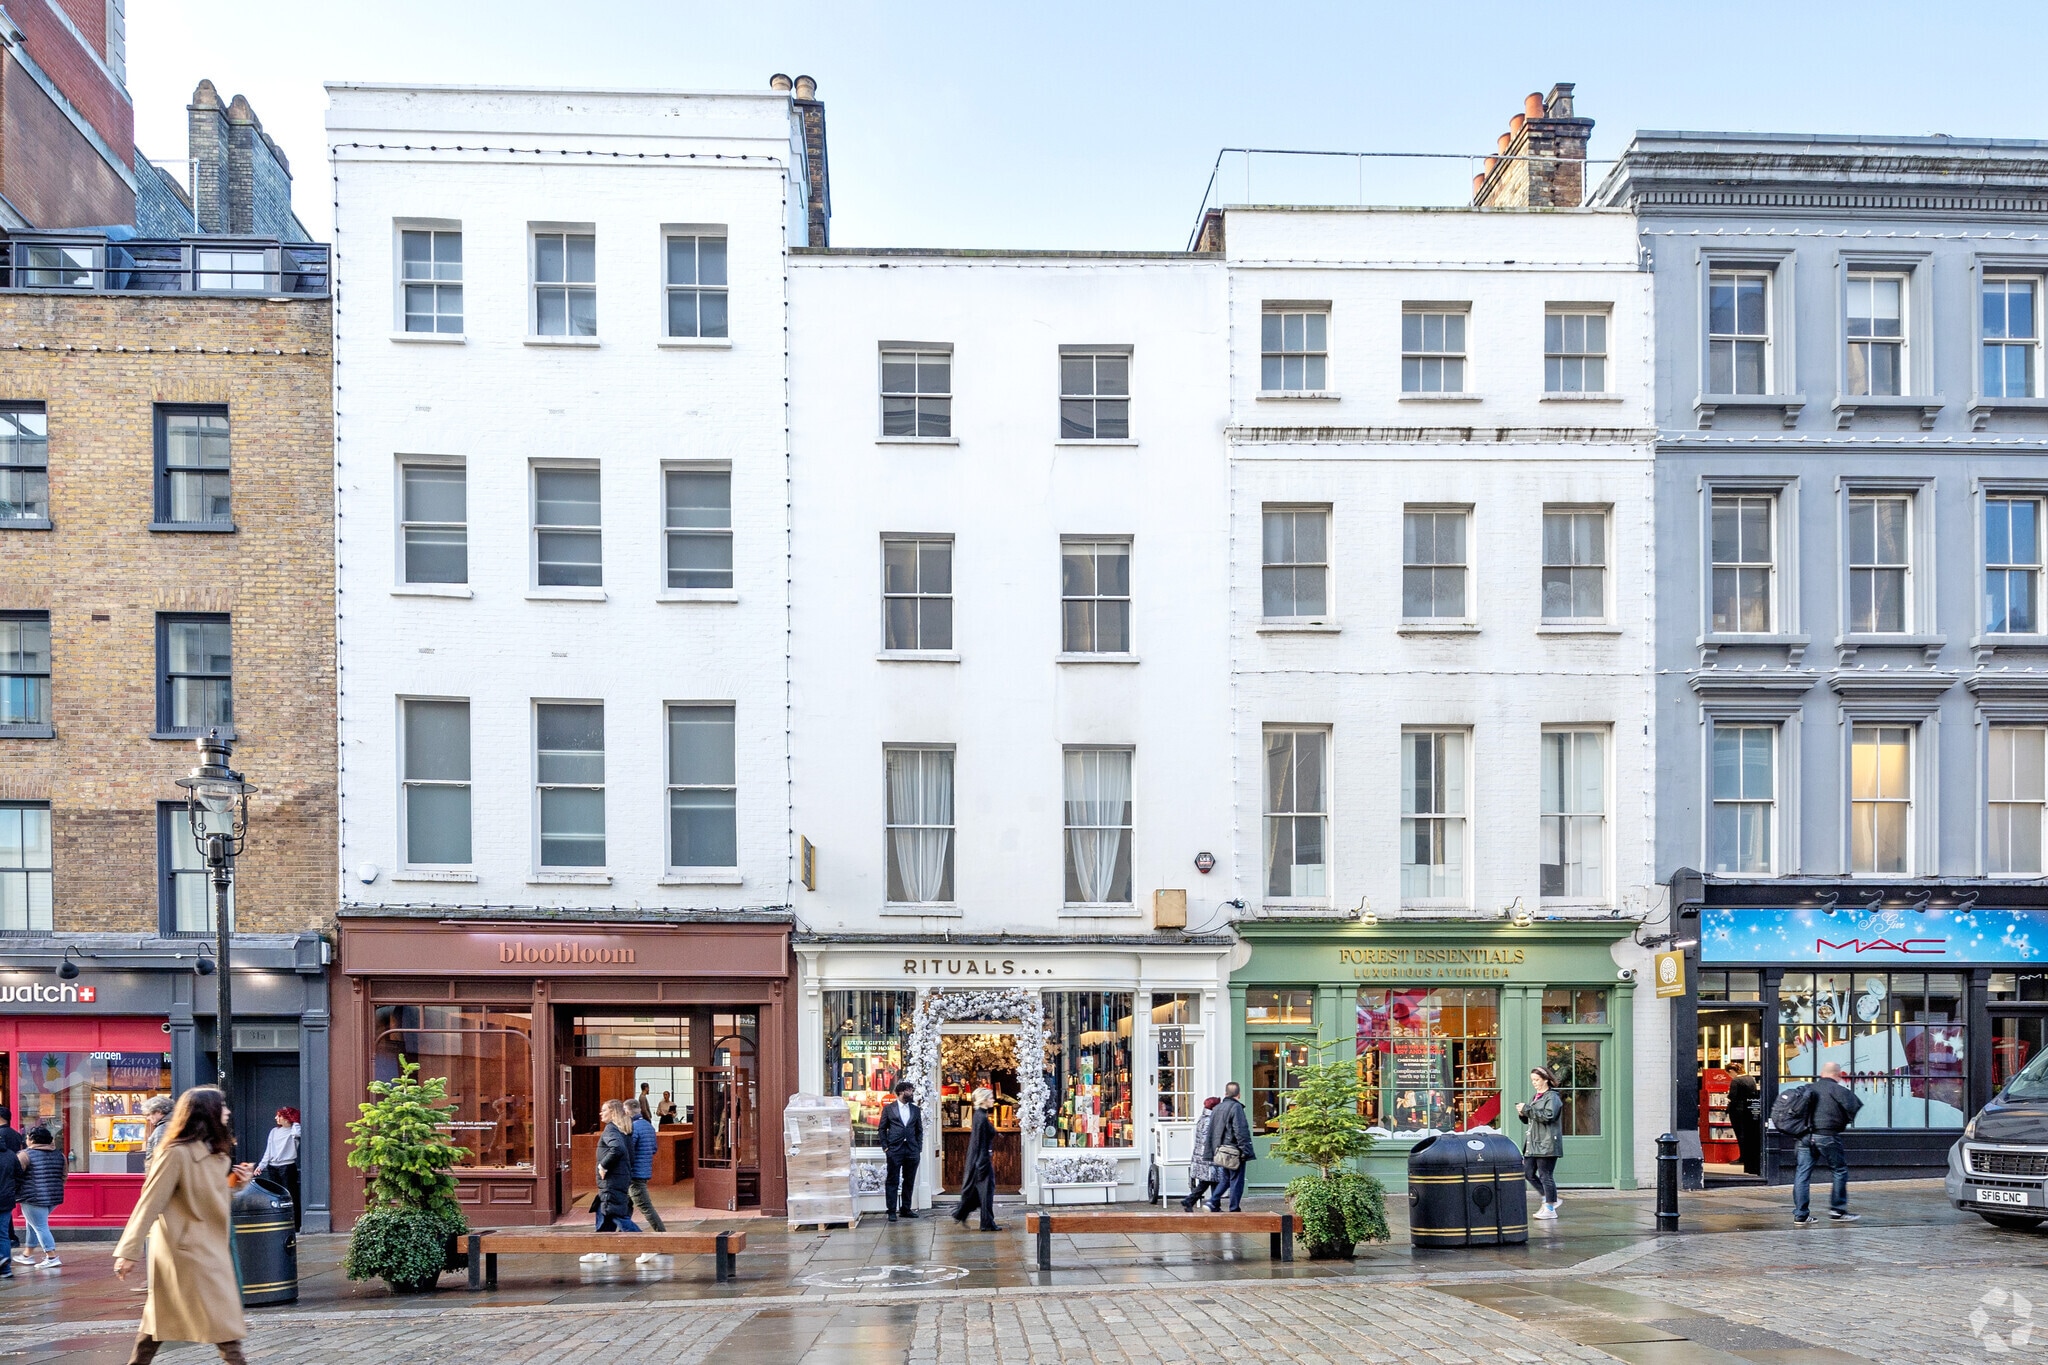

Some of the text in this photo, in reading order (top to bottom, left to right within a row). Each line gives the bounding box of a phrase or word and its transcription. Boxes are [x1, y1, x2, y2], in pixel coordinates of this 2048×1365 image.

[1873, 912, 1905, 934] Give
[498, 941, 636, 964] bloobloom
[1339, 949, 1526, 964] FOREST ESSENTIALS
[1354, 967, 1510, 979] LUXURIOUS AYURVEDA
[1981, 1190, 2022, 1203] SF16 CNC
